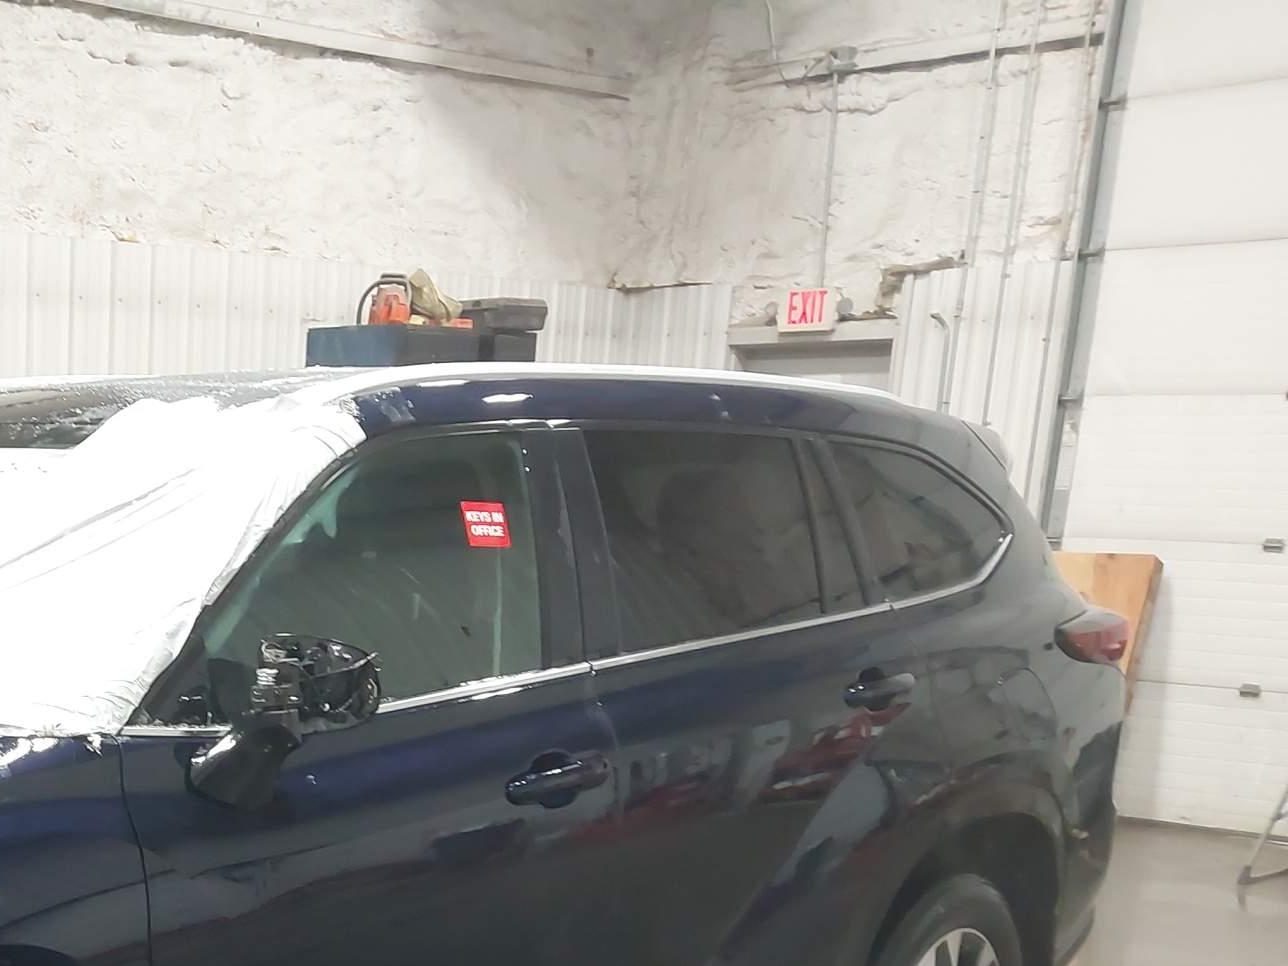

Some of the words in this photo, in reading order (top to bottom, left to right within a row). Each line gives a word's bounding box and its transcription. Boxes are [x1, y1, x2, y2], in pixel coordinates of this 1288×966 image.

[788, 289, 828, 325] EXIT
[465, 511, 492, 522] KEYS
[492, 511, 504, 522] IN
[471, 525, 505, 537] OFFICE
